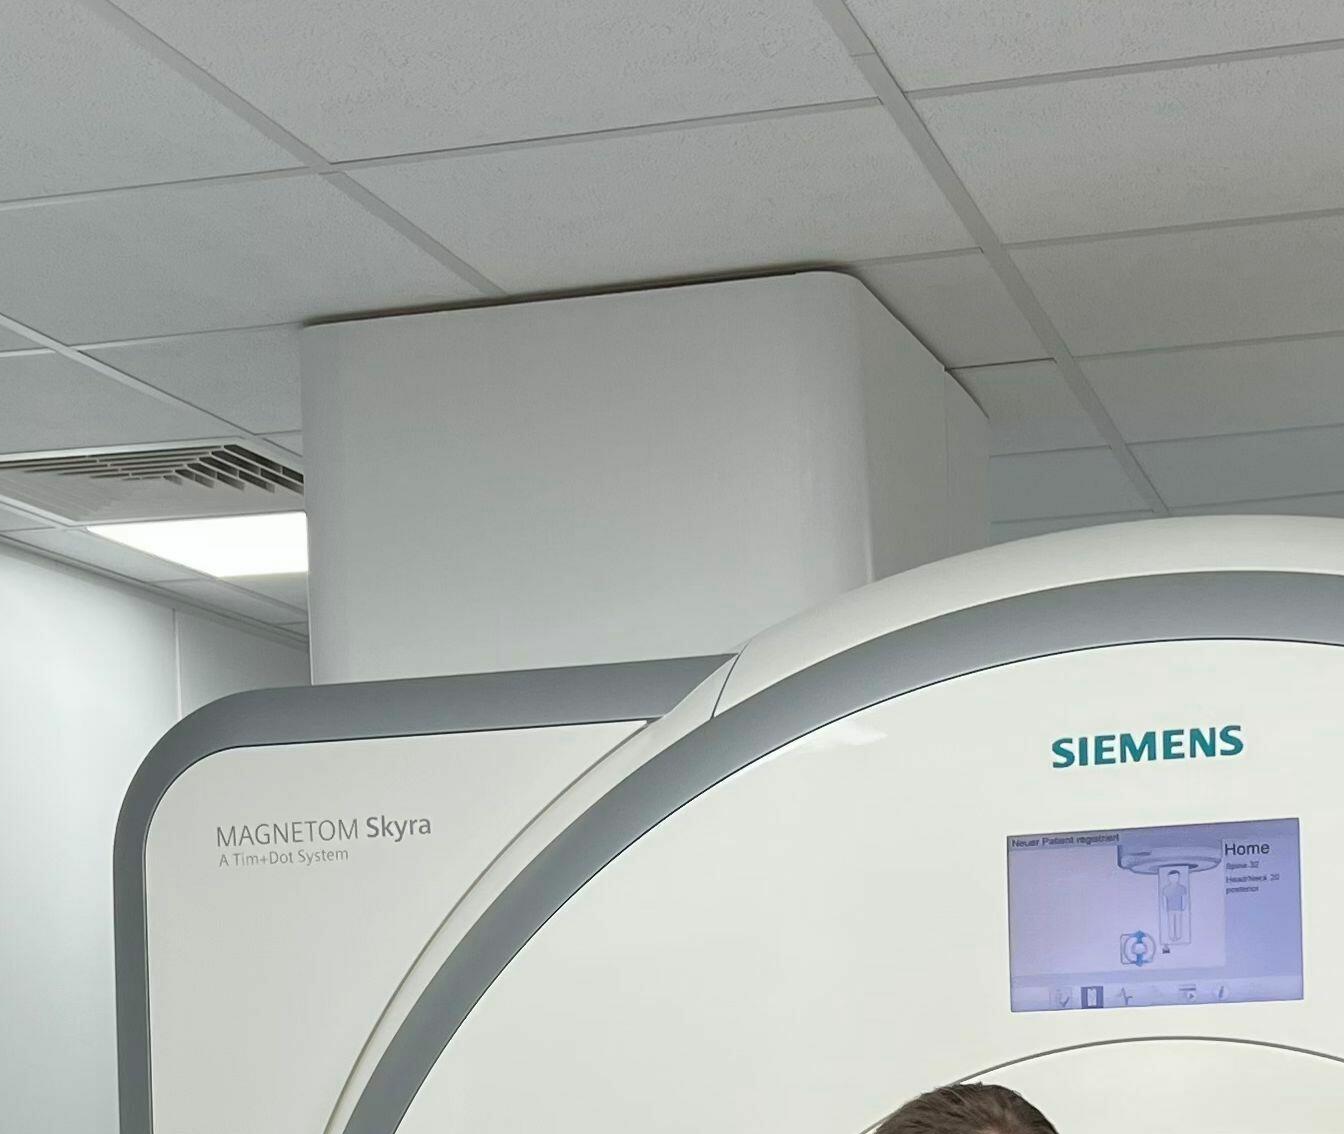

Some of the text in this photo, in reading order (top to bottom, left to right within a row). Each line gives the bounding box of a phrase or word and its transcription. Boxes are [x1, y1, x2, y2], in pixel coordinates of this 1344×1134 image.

[1051, 724, 1244, 768] SIEMENS
[216, 815, 431, 848] MAGNETOM Skyra
[219, 849, 349, 867] A Tim+Dot System
[1225, 843, 1270, 856] Home
